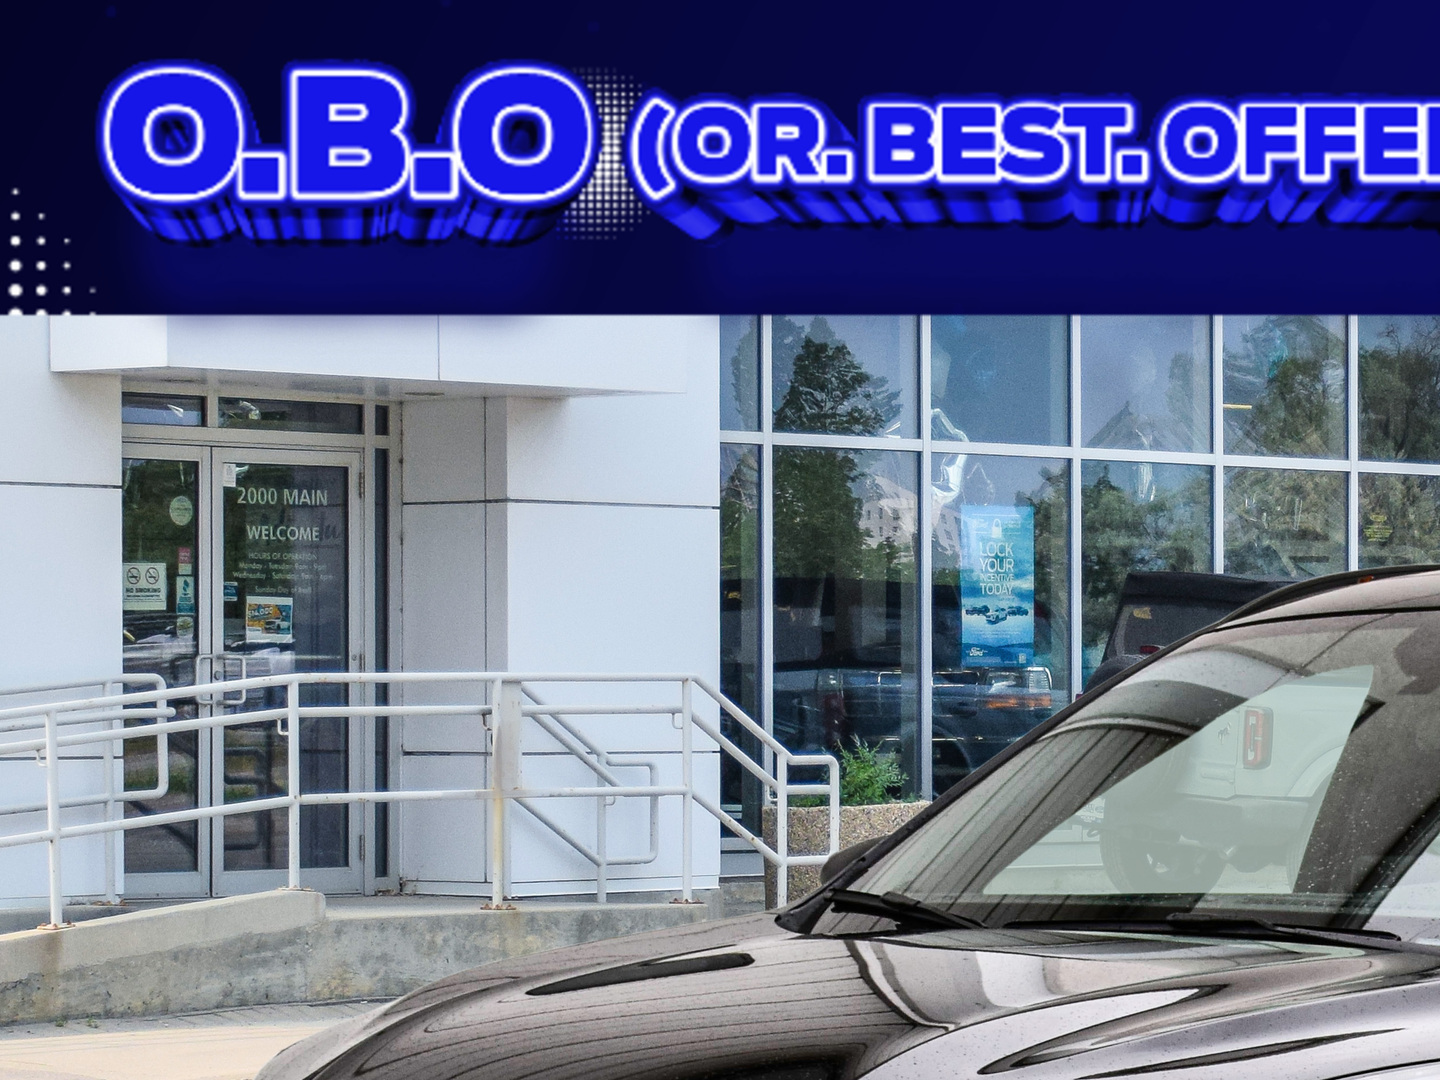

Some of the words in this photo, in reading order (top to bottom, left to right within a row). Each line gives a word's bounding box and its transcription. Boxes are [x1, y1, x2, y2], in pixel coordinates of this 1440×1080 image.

[237, 487, 277, 505] 2000
[283, 489, 328, 506] MAIN
[247, 525, 320, 542] WELCOME
[248, 552, 271, 560] HOURS
[980, 541, 1014, 557] LOCK
[979, 558, 1014, 573] YOUR
[979, 583, 1014, 595] TODAY
